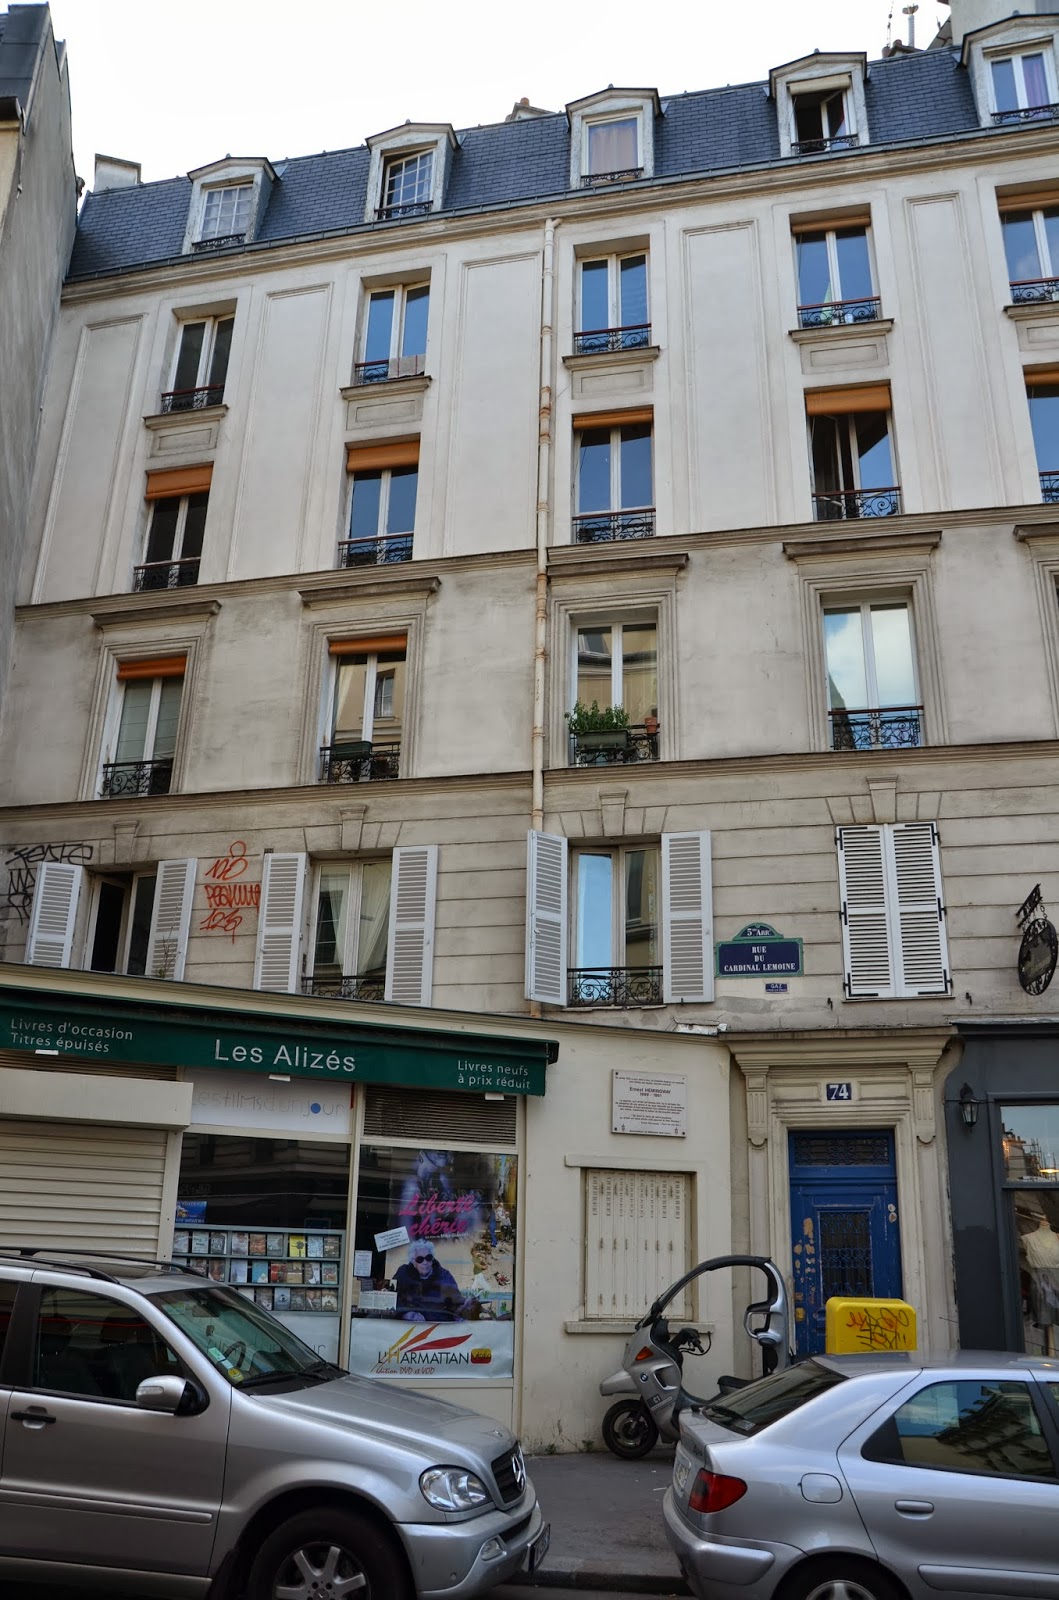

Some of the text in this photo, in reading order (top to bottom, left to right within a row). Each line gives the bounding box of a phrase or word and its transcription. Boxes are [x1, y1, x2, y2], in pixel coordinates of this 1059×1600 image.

[724, 963, 795, 972] CARDINAL LEMOINE
[11, 1018, 134, 1041] Livres d'occasion
[11, 1032, 110, 1053] Titres épuisés
[214, 1039, 356, 1073] Les Alizés
[458, 1060, 529, 1077] Livres neufs
[458, 1073, 531, 1090] à prix réduit
[829, 1084, 849, 1100] 74
[399, 1192, 475, 1216] Liberté
[408, 1214, 469, 1237] chérie
[400, 1367, 413, 1375] DVD
[421, 1367, 435, 1375] VOD
